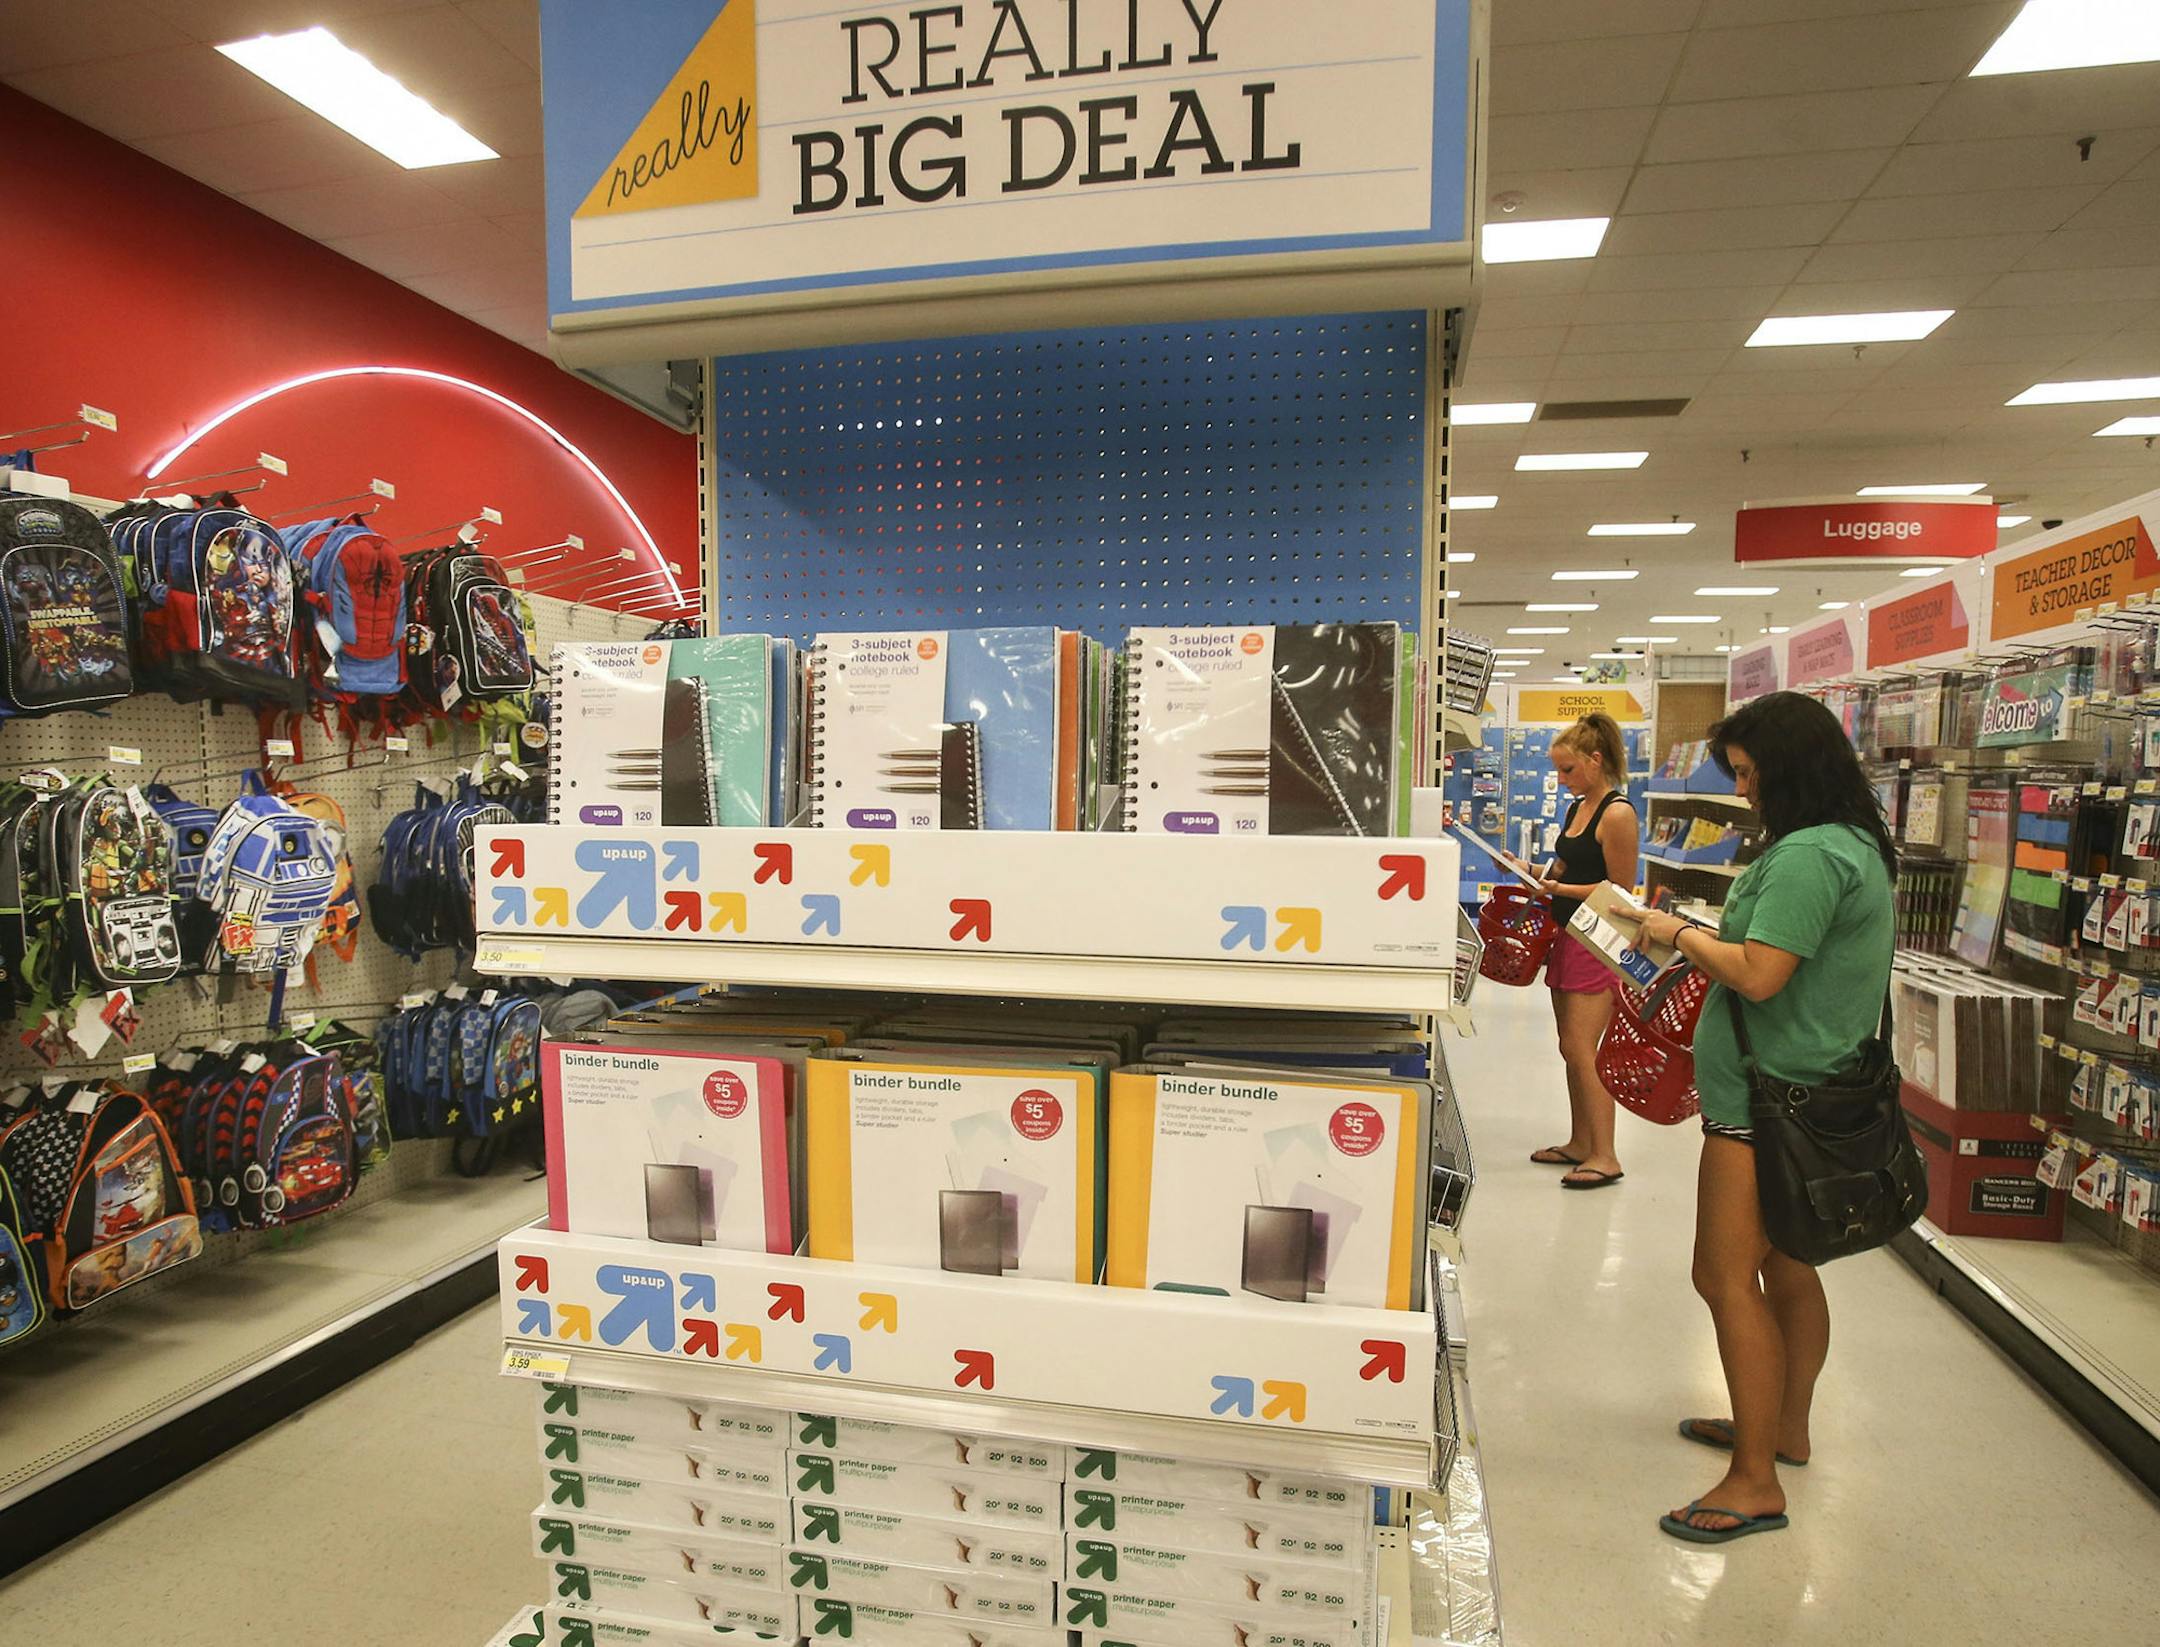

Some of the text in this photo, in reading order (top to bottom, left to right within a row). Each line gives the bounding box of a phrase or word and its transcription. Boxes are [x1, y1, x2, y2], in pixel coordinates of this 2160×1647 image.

[839, 0, 1218, 105] REALLY
[607, 80, 750, 208] really
[791, 82, 1301, 215] BIG DEAL
[1824, 519, 1922, 540] Luggage
[2015, 536, 2137, 593] TEACHER DECOR
[2029, 573, 2112, 616] & STORAGE
[852, 639, 912, 652] 3-subject
[1169, 633, 1235, 647] 3-subject
[851, 652, 911, 663] notebook
[849, 663, 919, 678] college ruled
[1168, 660, 1243, 673] coege ruled
[1560, 696, 1605, 706] SCHOOL
[1983, 696, 2038, 735] elcome
[593, 810, 652, 821] up&up 120
[863, 813, 930, 826] up&up 120
[1182, 816, 1257, 829] up&up 120
[602, 848, 648, 861] up&up
[565, 1053, 660, 1072] binder bundle
[854, 1074, 962, 1091] binder bundle
[715, 1083, 731, 1099] $5
[1162, 1080, 1278, 1100] binder bundle
[1025, 1103, 1044, 1119] $5
[1344, 1116, 1364, 1134] $5
[1982, 1194, 2037, 1205] Basic-Duty
[622, 1273, 666, 1289] up&up
[509, 1357, 530, 1369] 3.59
[739, 1422, 773, 1433] 92 500
[582, 1429, 635, 1442] printer paper
[839, 1460, 896, 1472] printer paper
[1010, 1455, 1047, 1466] 92 500
[588, 1475, 641, 1488] printer paper
[1121, 1495, 1185, 1509] printer paper
[1306, 1489, 1345, 1502] 92 500
[1007, 1502, 1043, 1514] 92 500
[844, 1511, 902, 1523] printer paper
[578, 1523, 631, 1536] printer paper
[1304, 1541, 1343, 1551] 92 500
[1123, 1545, 1186, 1561] printer paper
[832, 1559, 889, 1572] printer paper
[1011, 1554, 1046, 1566] 92 500
[593, 1569, 646, 1582] printer paper
[1113, 1594, 1176, 1609] printer paper
[1305, 1592, 1343, 1604] 92 500
[856, 1605, 914, 1619] printer paper
[763, 1616, 780, 1625] 500
[598, 1623, 651, 1637] printer paper
